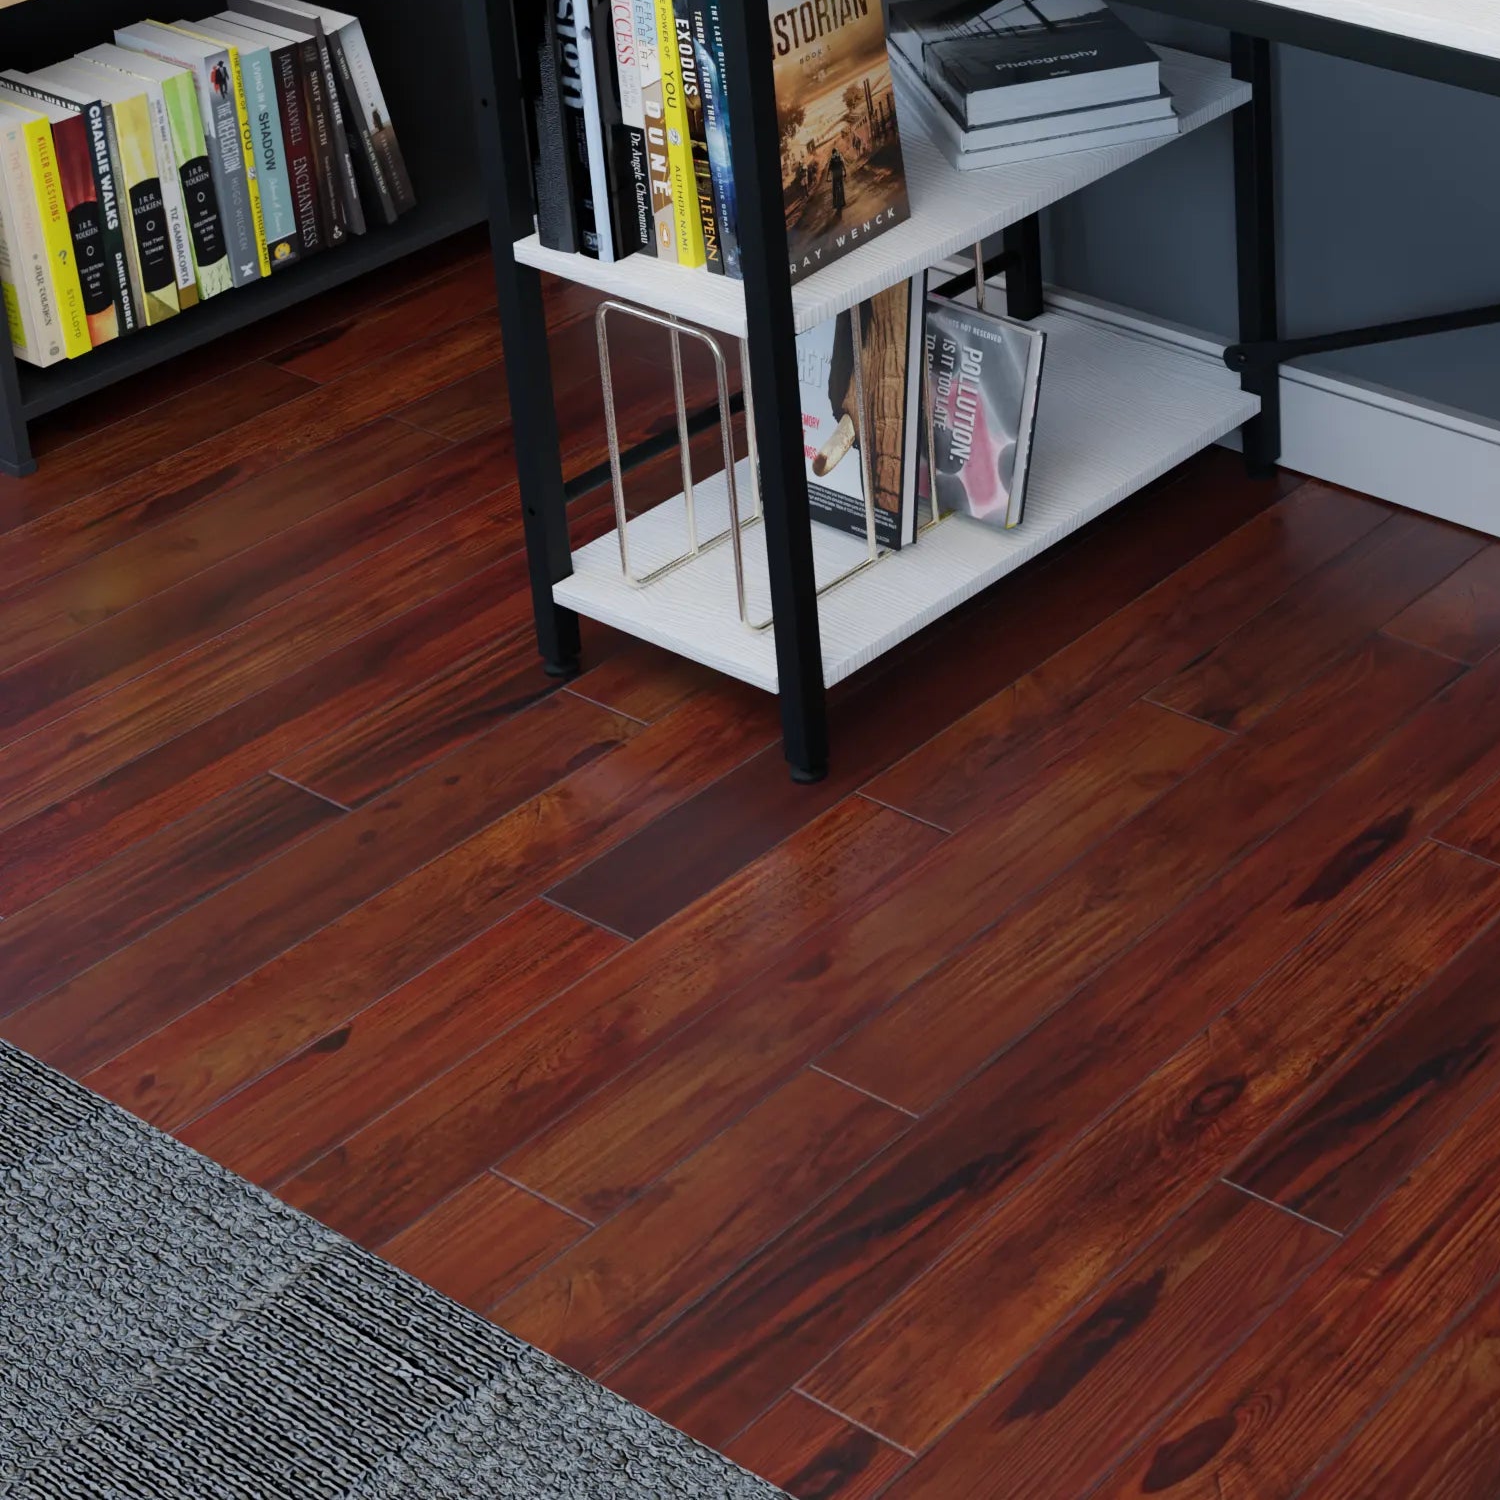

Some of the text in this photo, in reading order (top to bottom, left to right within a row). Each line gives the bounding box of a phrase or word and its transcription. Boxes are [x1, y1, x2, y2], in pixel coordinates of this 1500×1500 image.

[643, 1, 656, 59] FRANK
[660, 8, 669, 44] POWER
[694, 11, 706, 45] TERROR
[710, 5, 719, 21] THE
[664, 48, 671, 60] OF
[675, 18, 698, 96] EXODUS
[995, 48, 1099, 71] Photography
[279, 53, 303, 146] JAMES MAXWELL
[664, 70, 677, 110] YOU
[241, 120, 252, 151] YOU
[258, 112, 276, 172] SHADOW
[645, 100, 672, 197] DUNE
[43, 170, 60, 222] QUESTIONS
[89, 106, 119, 230] CHARLIE WALKS
[630, 132, 649, 244] Dr. Angele Charbonneau
[293, 156, 318, 248] ENCHANTRESS
[675, 165, 688, 253] AUTHOR NAME
[790, 207, 895, 275] RAY WENCK
[115, 252, 133, 330] DANIEL BOURKE
[936, 372, 954, 397] TOO
[940, 354, 954, 372] IT
[933, 396, 951, 432] LATE
[949, 345, 984, 465] POLLUTION:
